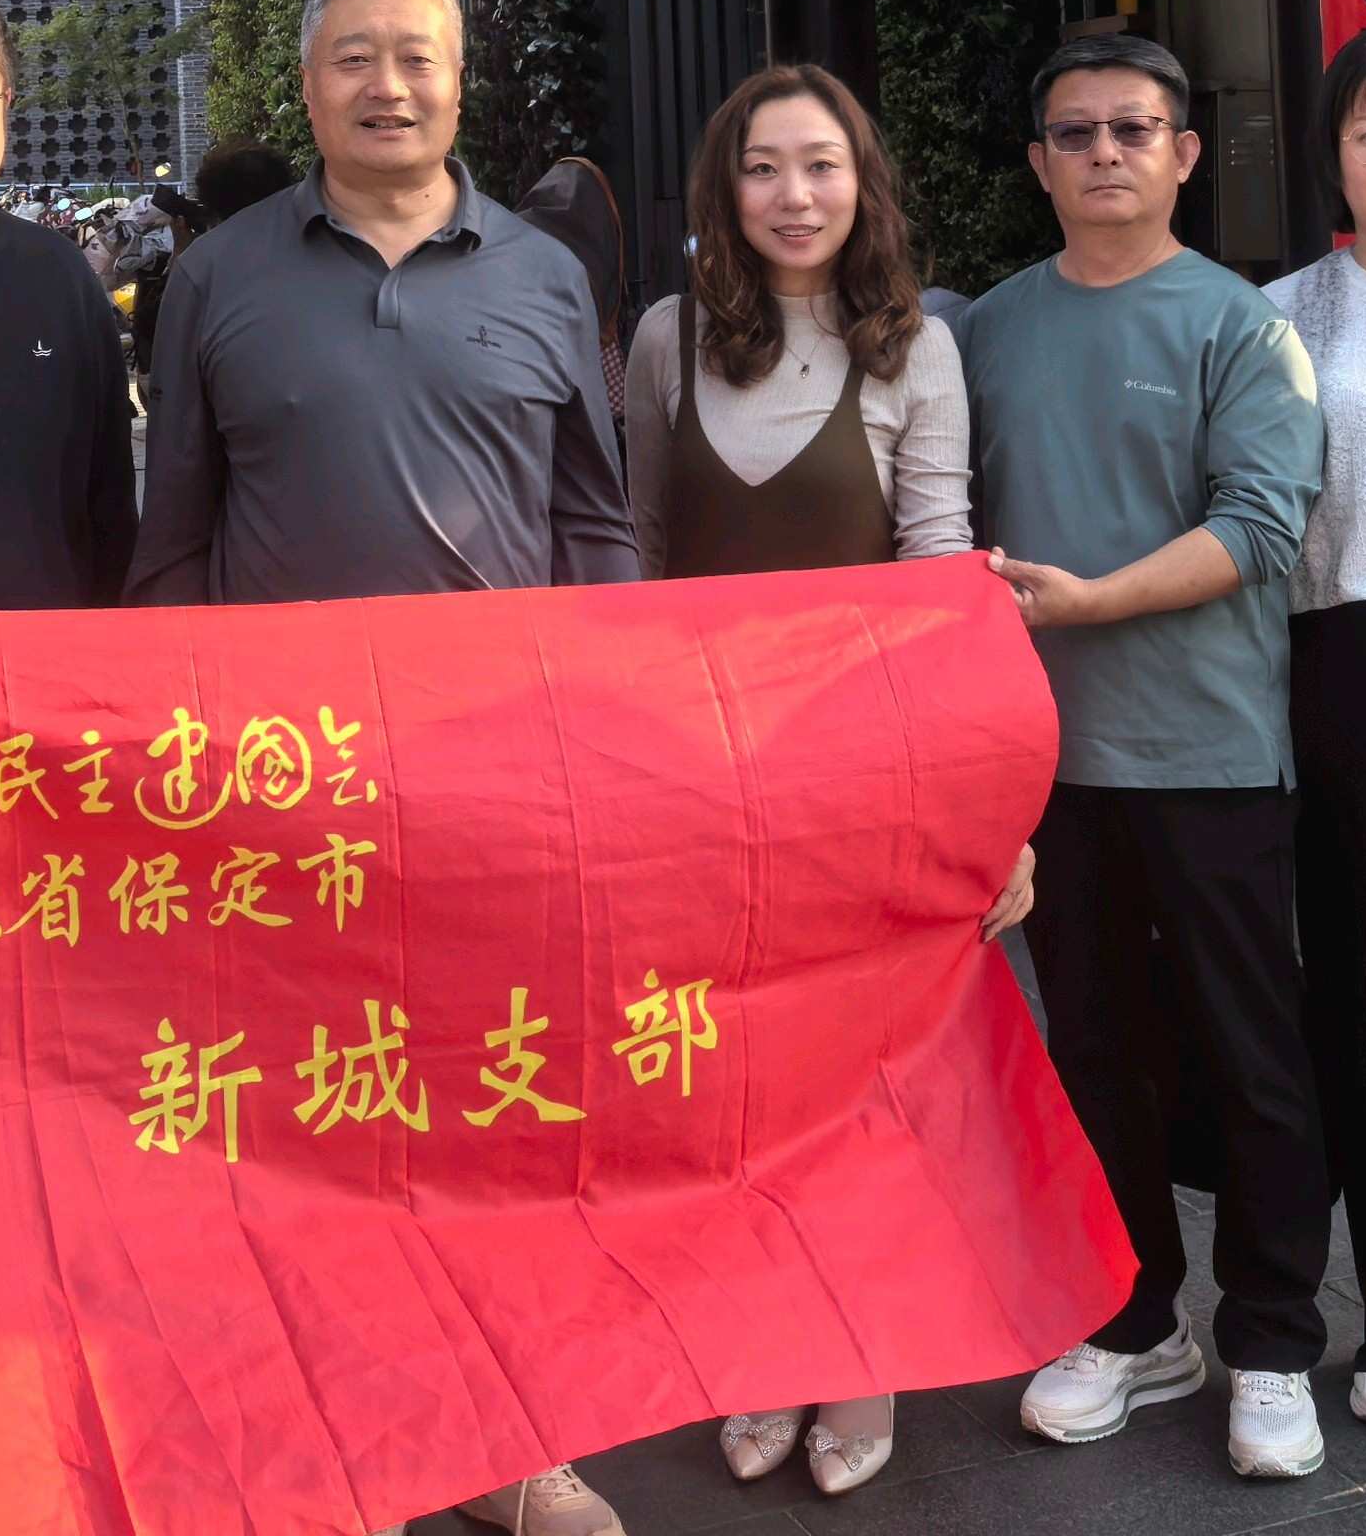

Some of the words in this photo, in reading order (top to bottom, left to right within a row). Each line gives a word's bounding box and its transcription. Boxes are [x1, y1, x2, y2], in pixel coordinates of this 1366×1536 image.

[1133, 379, 1177, 396] Columbia
[128, 966, 720, 1165] 新城支部
